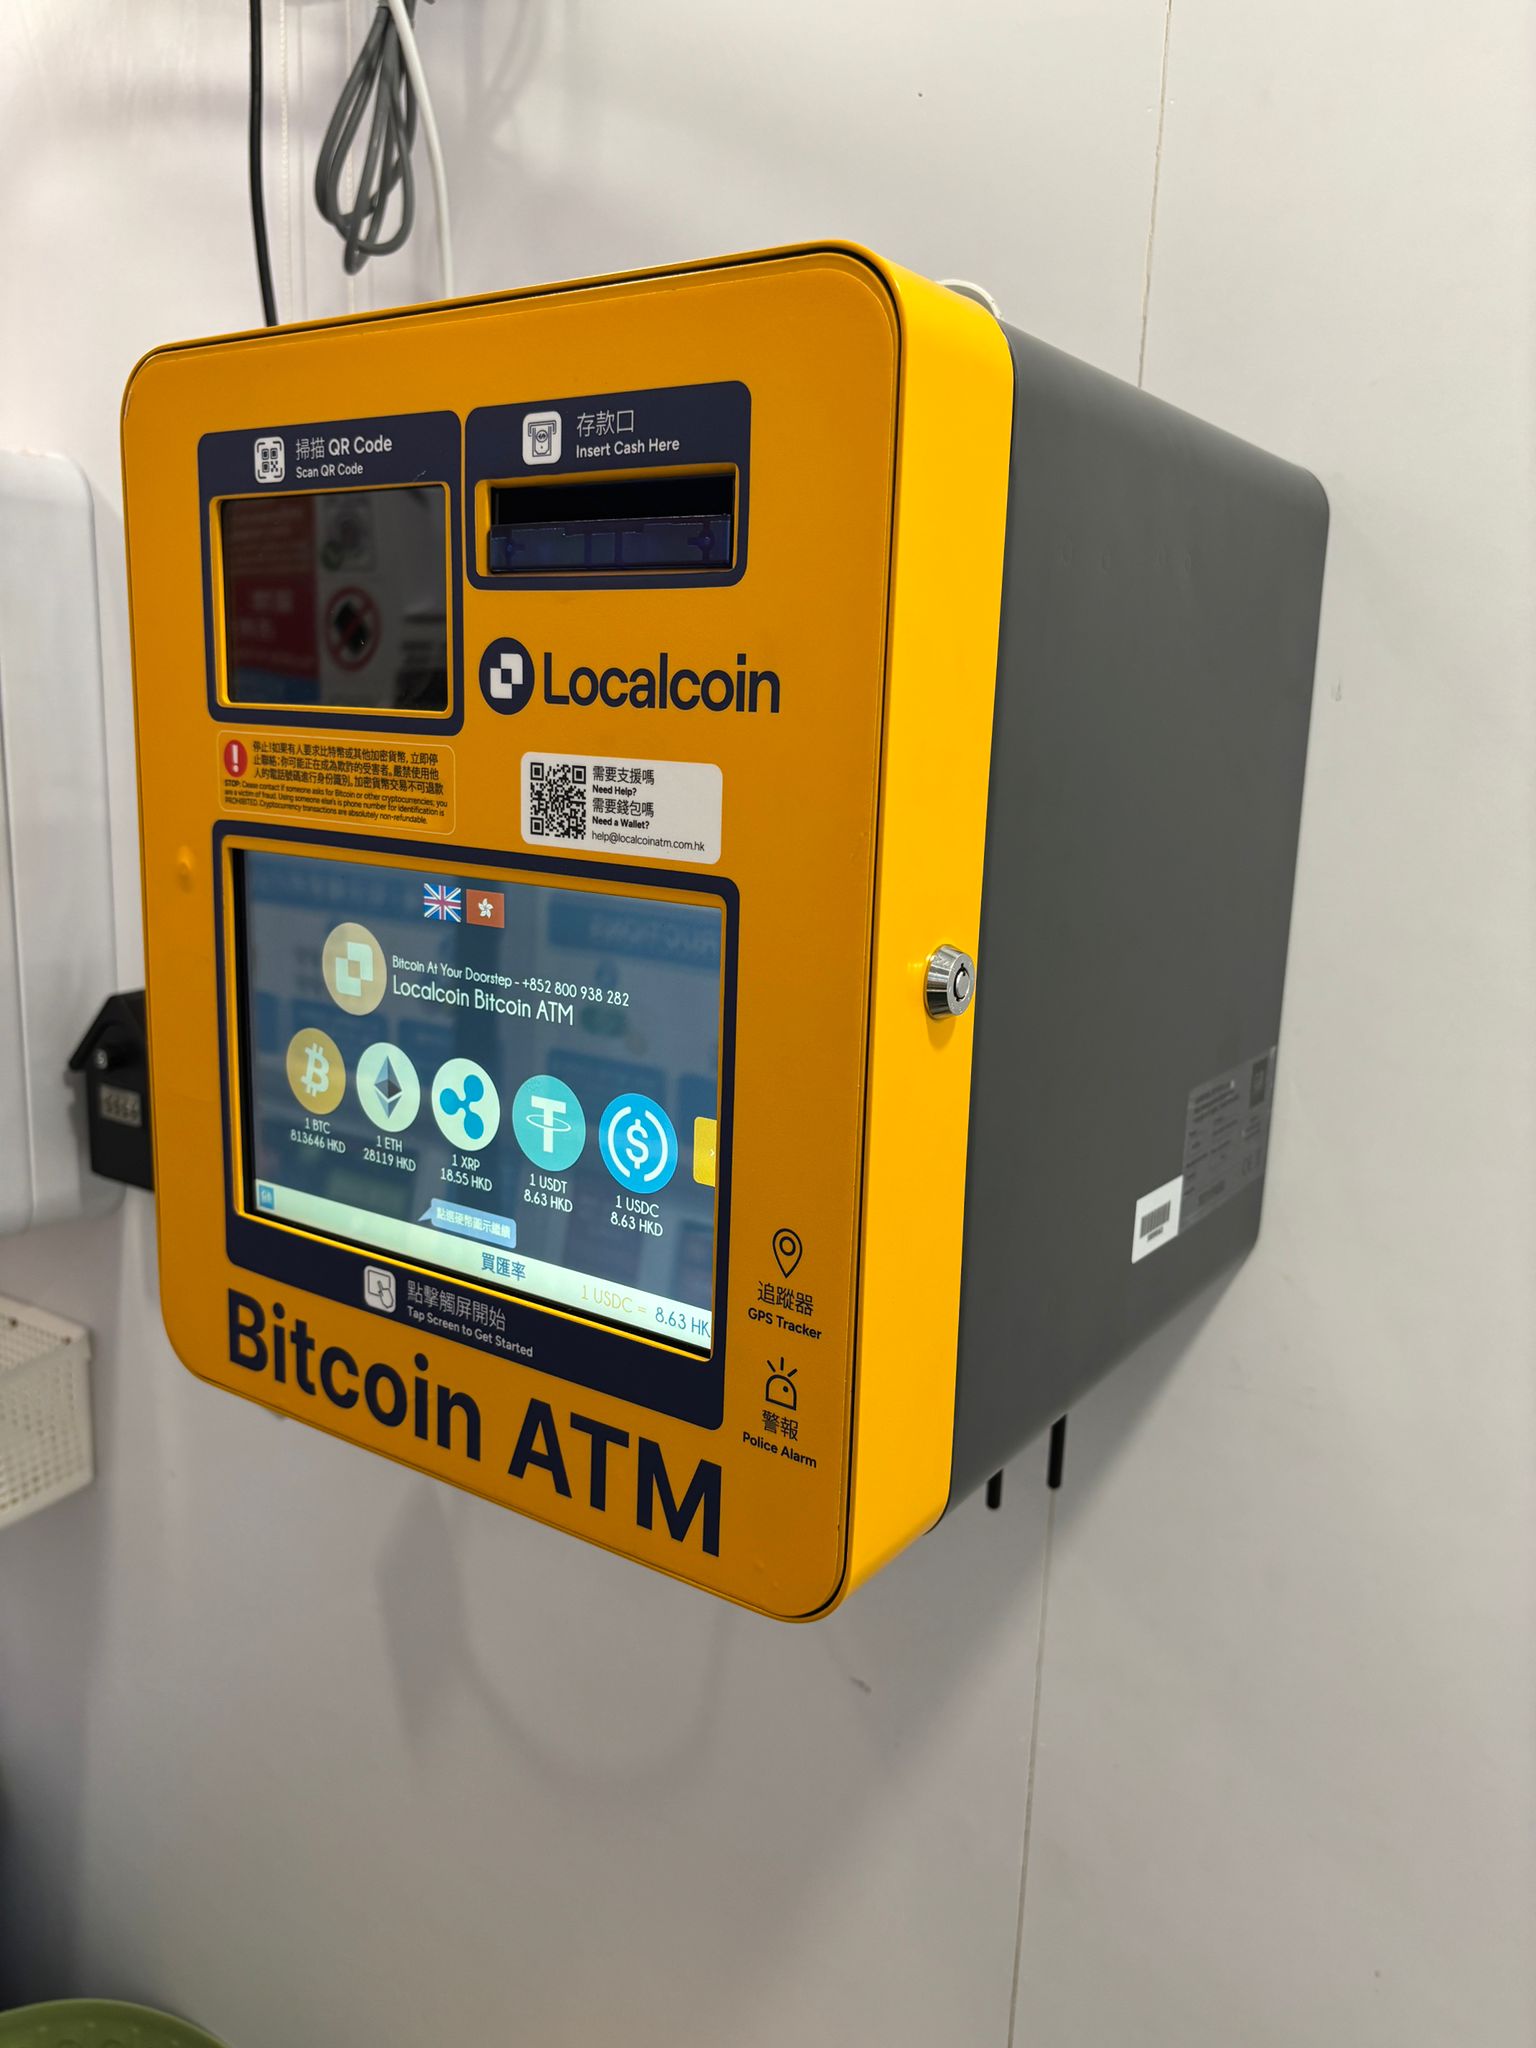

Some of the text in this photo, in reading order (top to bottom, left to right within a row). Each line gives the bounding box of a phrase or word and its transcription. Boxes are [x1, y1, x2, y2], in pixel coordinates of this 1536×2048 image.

[576, 409, 634, 437] 存款口
[296, 435, 393, 460] 掃描 QR Code
[576, 437, 680, 458] Insert Cash Here
[296, 462, 363, 479] Scan QR Code
[544, 652, 781, 713] Localcoin
[592, 765, 655, 785] 需要支援嗎
[259, 783, 280, 791] contact
[286, 786, 311, 794] someone
[312, 787, 324, 795] asks
[325, 788, 334, 796] for
[335, 789, 355, 798] Bitcoin
[363, 792, 381, 801] other
[436, 800, 448, 808] you
[592, 784, 637, 798] Need Help?
[260, 799, 301, 812] Cryptocurrency
[302, 804, 336, 814] transactions
[348, 808, 379, 820] absolutely
[278, 793, 294, 802] Using
[295, 796, 320, 804] someone
[343, 799, 362, 809] phone
[363, 801, 386, 810] number
[387, 803, 397, 811] for
[398, 804, 438, 815] identification
[439, 808, 444, 817] is
[592, 797, 655, 818] 需要錢包嗎
[592, 815, 650, 830] Need a Wallet?
[591, 830, 705, 852] help@localcoinatm.com.hk
[392, 955, 425, 973] Bitcoin
[427, 961, 438, 975] At
[440, 962, 463, 979] Your
[465, 966, 513, 989] Doorstep
[521, 978, 551, 994] +852
[554, 982, 577, 998] 800
[580, 986, 603, 1002] 938
[607, 990, 630, 1007] 282
[392, 974, 574, 1026] Localcoin Bitcoin ATM
[305, 1117, 331, 1134] 1 BTC
[290, 1129, 346, 1154] 813646 HKD
[376, 1135, 403, 1153] 1 ETH
[363, 1147, 416, 1172] 28119 HKD
[451, 1154, 481, 1172] 1 XRP
[440, 1167, 493, 1192] 18.55 HKD
[529, 1173, 568, 1194] 1 USDT
[524, 1189, 573, 1213] 8.63 HKD
[616, 1195, 660, 1218] 1 USDC
[610, 1211, 663, 1237] 8.63 HKD
[482, 1252, 526, 1281] 買匯率
[407, 1279, 506, 1332] 點擊觸屏開始
[580, 1284, 588, 1300] 1
[593, 1287, 633, 1313] USDC
[655, 1307, 687, 1330] 8.63
[757, 1280, 814, 1317] 追蹤器
[407, 1305, 533, 1358] Tap Screen to Get Started
[747, 1307, 822, 1340] GPS Tracker
[227, 1287, 722, 1558] Bitcoin ATM
[761, 1409, 799, 1442] 警報
[742, 1431, 817, 1469] Police Alarm
